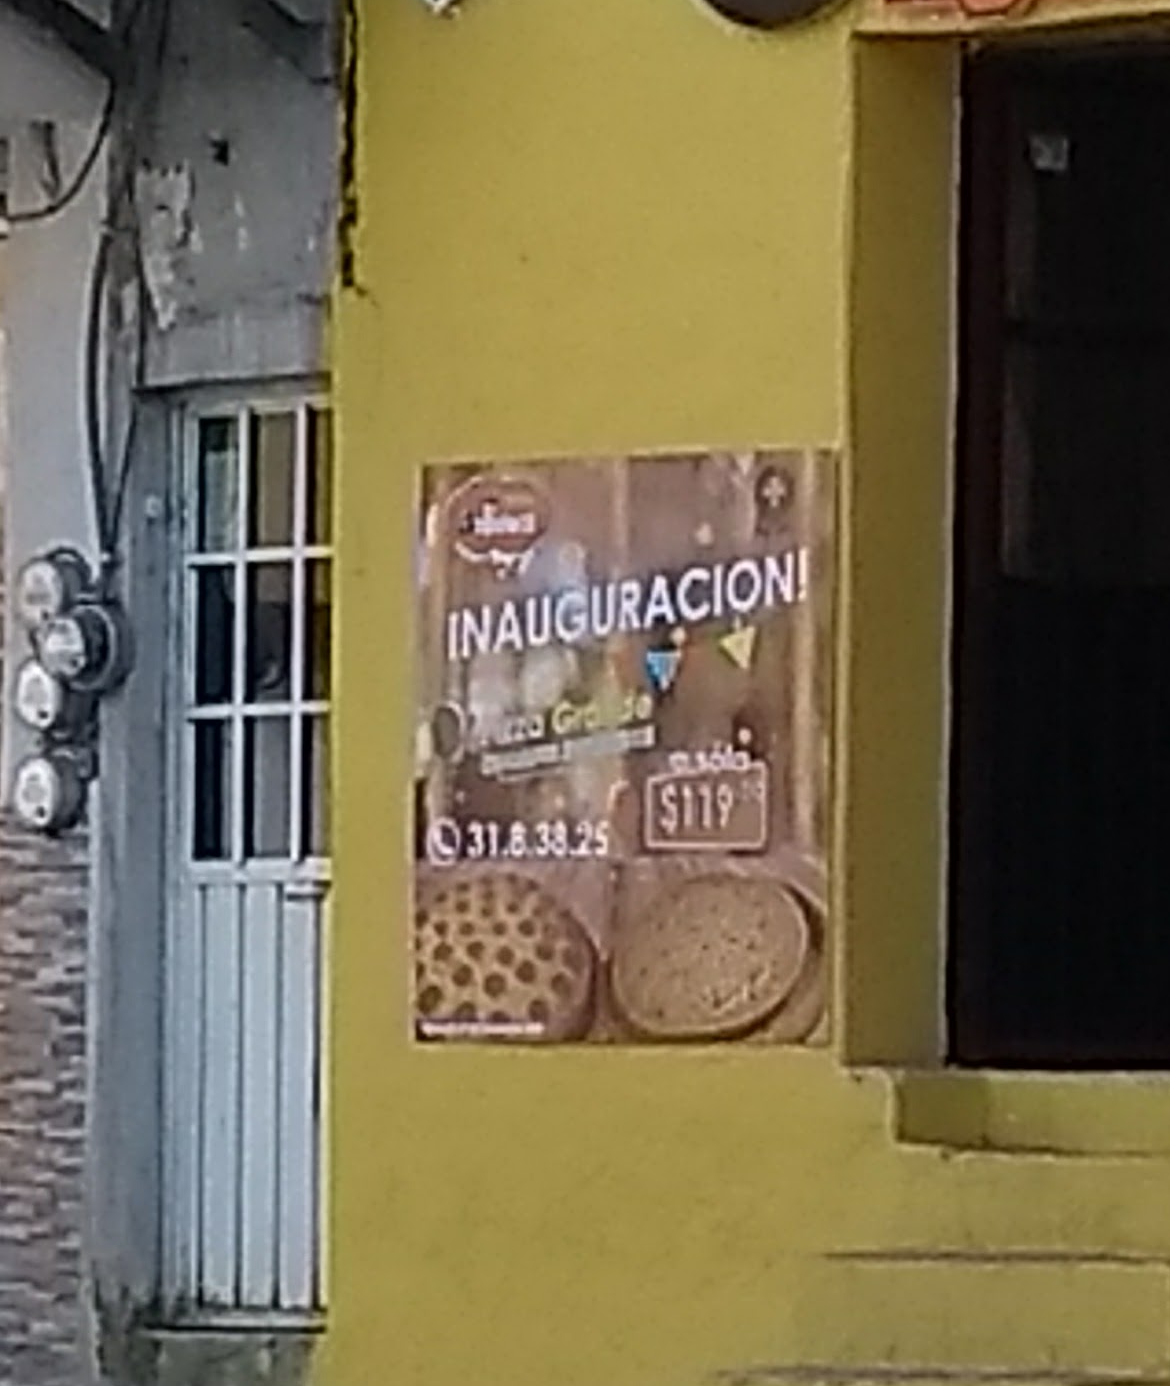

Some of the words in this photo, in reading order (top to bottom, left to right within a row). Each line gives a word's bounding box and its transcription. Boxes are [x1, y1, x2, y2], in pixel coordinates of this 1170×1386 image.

[447, 549, 809, 660] INAUGURACION!
[660, 783, 734, 835] $119
[466, 820, 609, 860] 31.8.38.25
